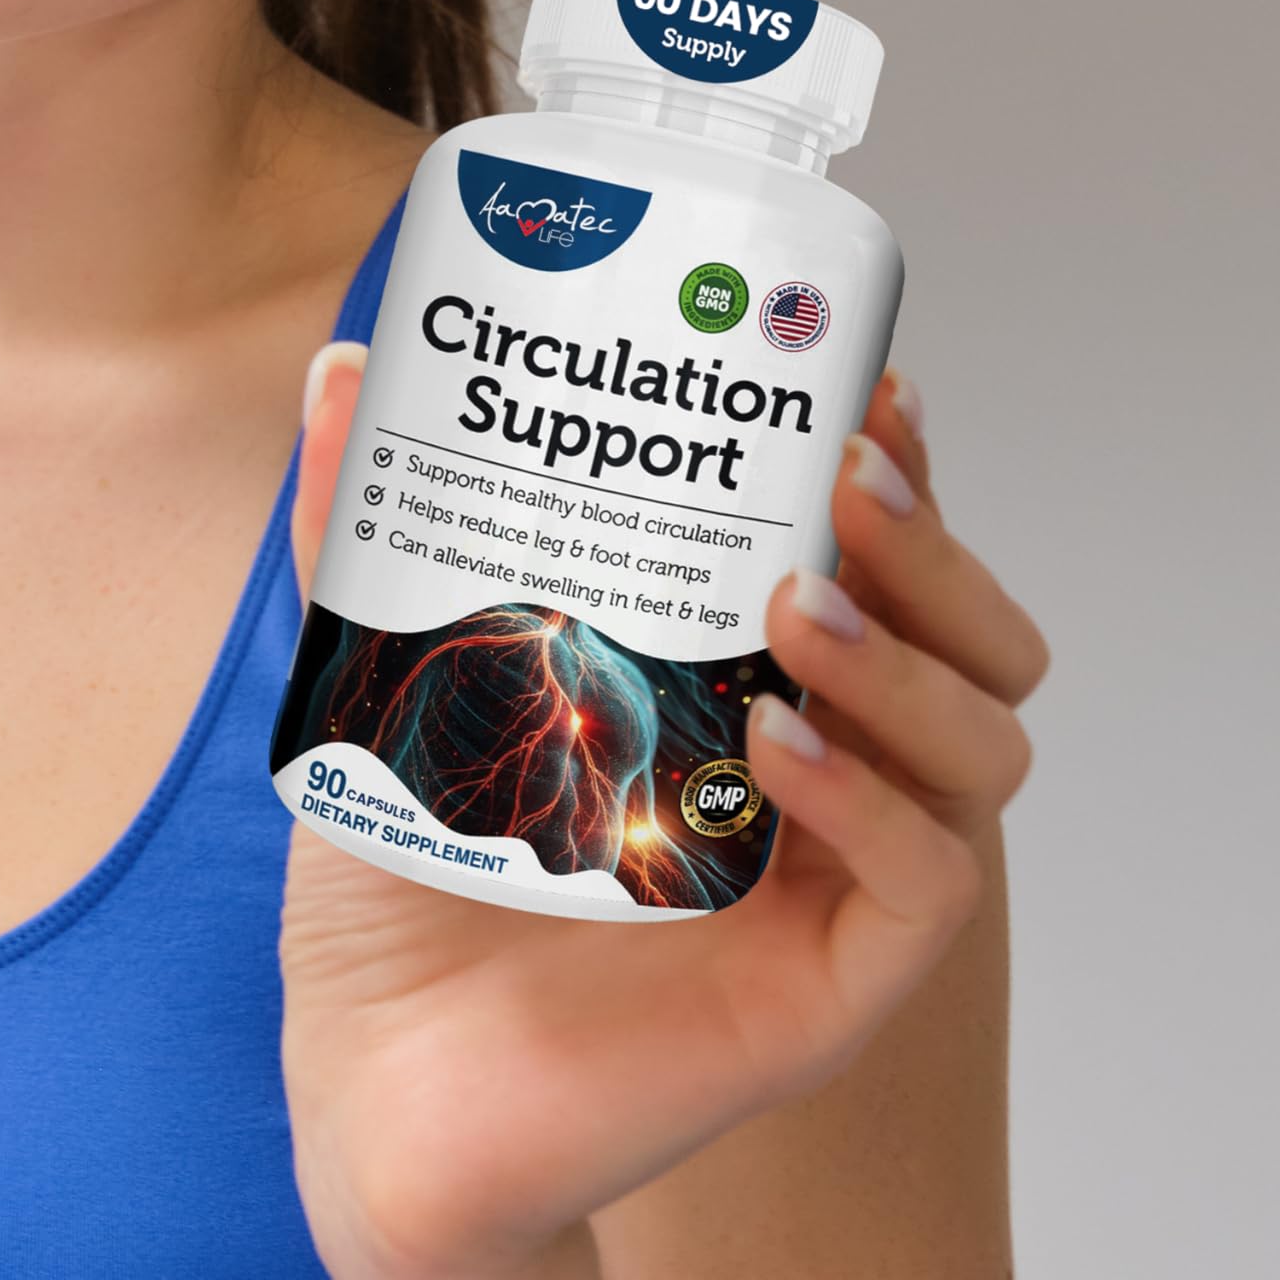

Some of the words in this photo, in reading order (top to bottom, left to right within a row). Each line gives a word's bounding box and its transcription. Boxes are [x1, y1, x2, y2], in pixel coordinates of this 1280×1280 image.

[661, 27, 746, 67] Supply
[695, 296, 729, 312] GMO
[696, 268, 721, 280] MADE
[722, 270, 741, 288] WITH
[698, 284, 732, 301] NON
[776, 286, 799, 297] MADE
[800, 286, 809, 294] IN
[810, 291, 822, 306] USA
[422, 295, 813, 434] Circulation
[458, 375, 744, 490] Support
[406, 454, 496, 495] Supports
[500, 480, 576, 518] healthy
[580, 500, 640, 530] blood
[644, 517, 752, 550] circulation
[398, 491, 454, 524] Helps
[459, 514, 528, 545] reduce
[534, 530, 565, 558] leg
[570, 539, 584, 558] &
[589, 544, 631, 568] foot
[636, 557, 711, 585] cramps
[388, 530, 428, 558] Can
[433, 546, 515, 582] alleviate
[520, 570, 605, 607] swelling
[609, 588, 628, 609] in
[634, 594, 673, 617] feet
[678, 601, 693, 620] &
[698, 605, 740, 630] legs
[307, 761, 347, 799] 90
[346, 788, 416, 823] CAPSULES
[698, 784, 746, 811] GMP
[301, 793, 379, 835] DIETARY
[381, 825, 509, 874] SUPPLEMENT
